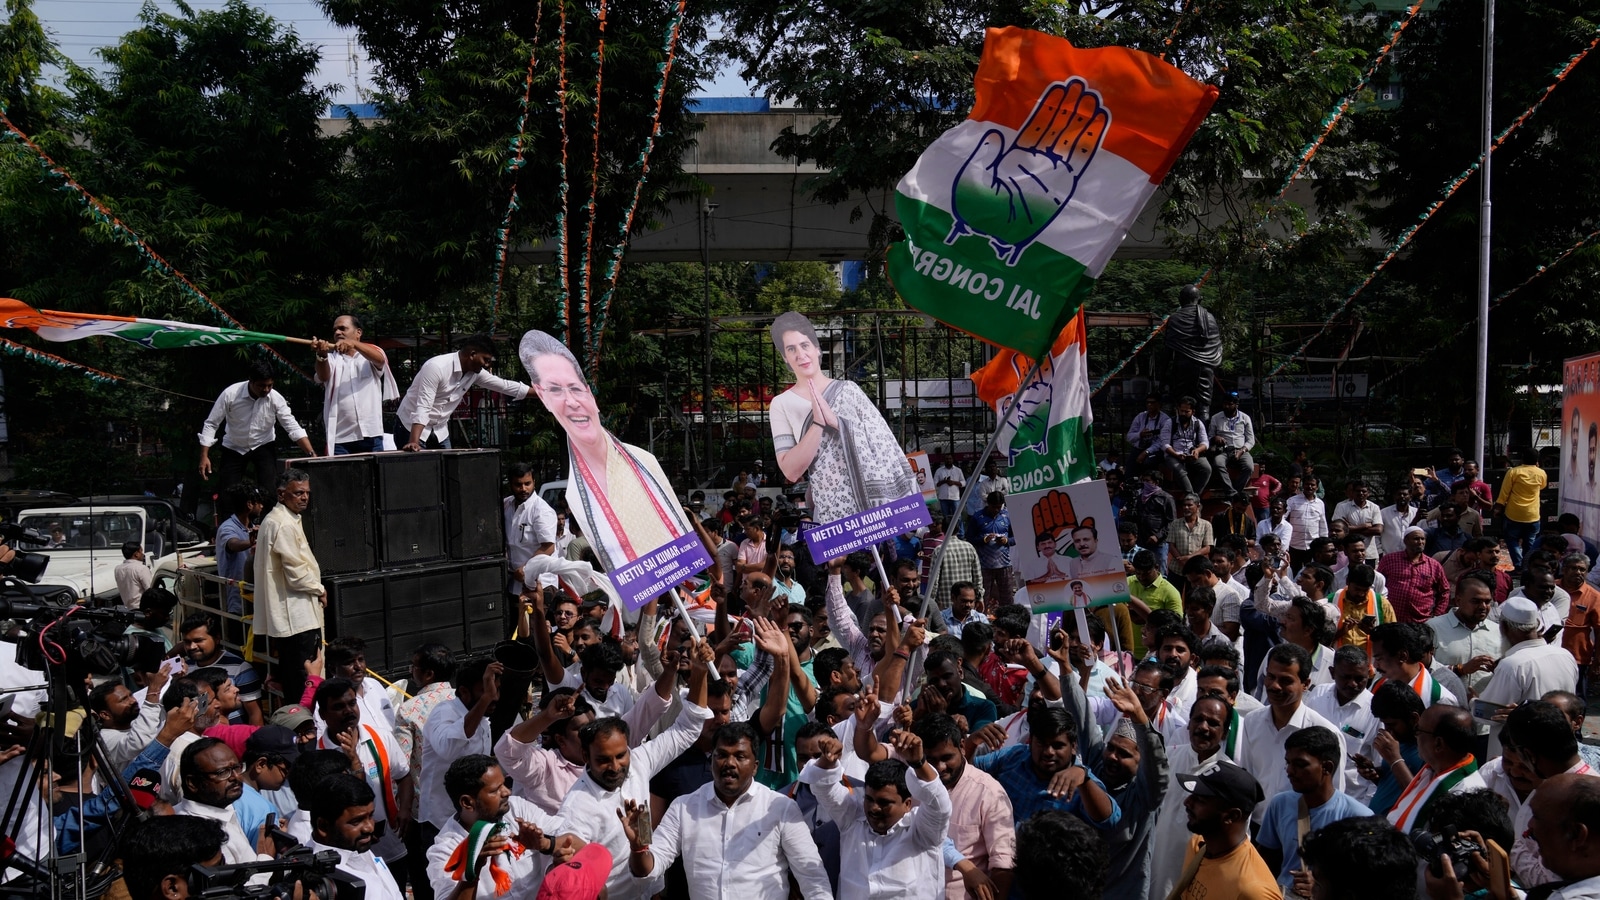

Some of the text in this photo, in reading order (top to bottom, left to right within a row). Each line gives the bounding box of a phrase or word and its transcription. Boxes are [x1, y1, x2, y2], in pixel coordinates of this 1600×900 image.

[811, 501, 920, 543] METTU SAI KUMAR M.COM, LLB
[822, 537, 863, 558] FISHERMEN
[863, 526, 899, 544] CONGRESS
[903, 517, 922, 529] TPCC
[853, 521, 887, 538] CHAIRMAN
[615, 563, 645, 586] METTU
[642, 556, 658, 572] SAI
[655, 545, 681, 566] KUMAR
[633, 579, 666, 603] FISHERMEN
[664, 566, 691, 585] CONGRESS
[692, 557, 706, 570] TPCC
[654, 560, 680, 579] CHAIRMAN
